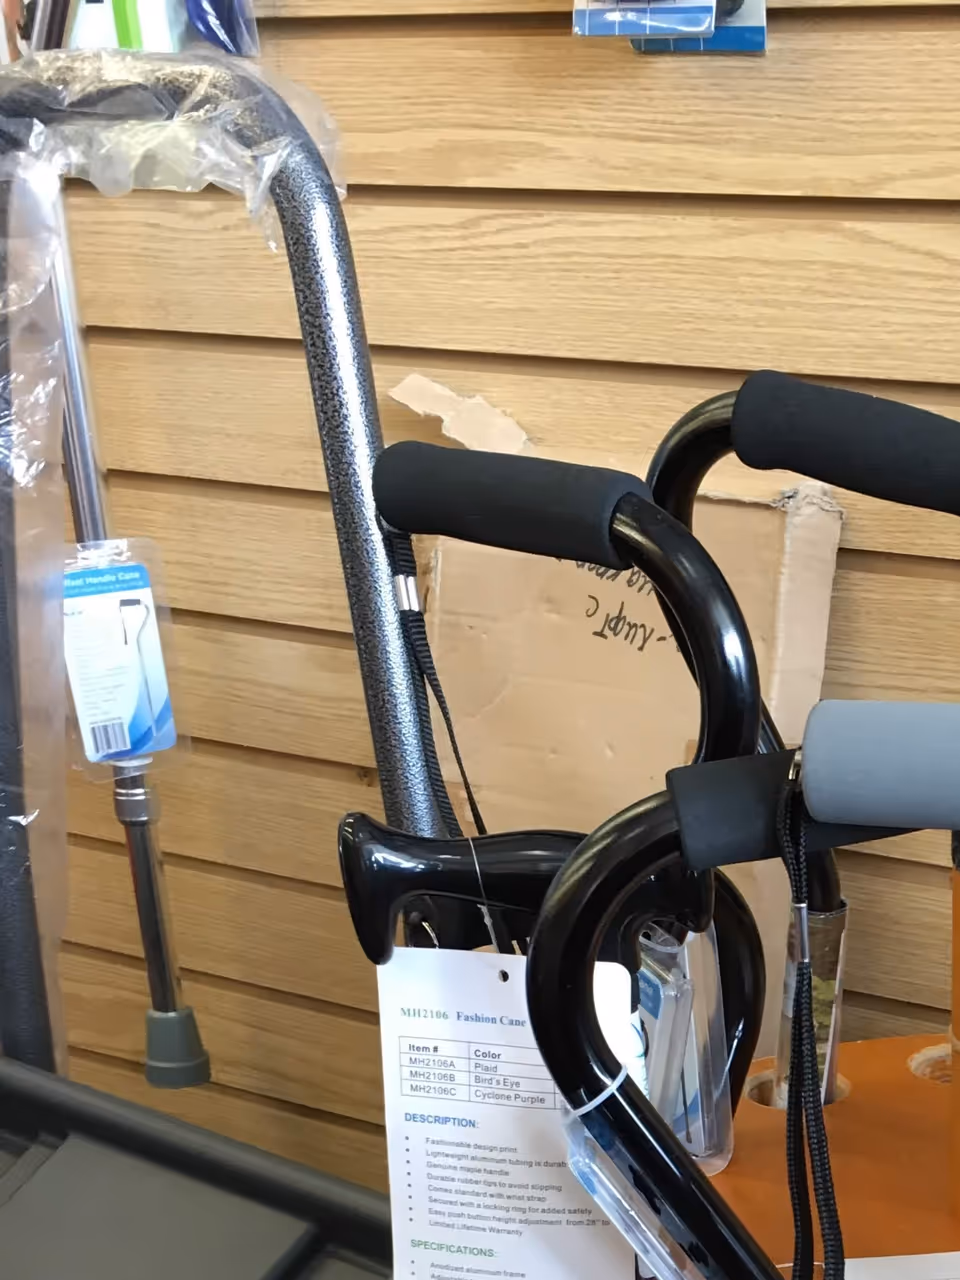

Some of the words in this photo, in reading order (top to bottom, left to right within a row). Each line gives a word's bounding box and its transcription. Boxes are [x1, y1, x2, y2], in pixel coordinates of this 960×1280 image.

[400, 1007, 449, 1020] MH2106
[456, 1011, 497, 1025] Fashion
[499, 1016, 527, 1027] Cane
[408, 1043, 431, 1053] Item
[474, 1049, 502, 1060] Color
[409, 1057, 456, 1069] MH2106A
[474, 1062, 498, 1073] Plaid
[409, 1070, 456, 1082] MH2106B
[503, 1077, 521, 1089] Eye
[410, 1084, 457, 1096] MH2106C
[474, 1090, 512, 1102] Cyclone
[514, 1094, 546, 1105] Purple
[404, 1112, 480, 1129] DESCRIPTION:
[473, 1143, 498, 1153] design
[426, 1149, 469, 1162] Lightweight
[483, 1201, 510, 1212] locking
[540, 1207, 566, 1215] added
[567, 1208, 592, 1216] safety
[489, 1226, 523, 1237] Warranty
